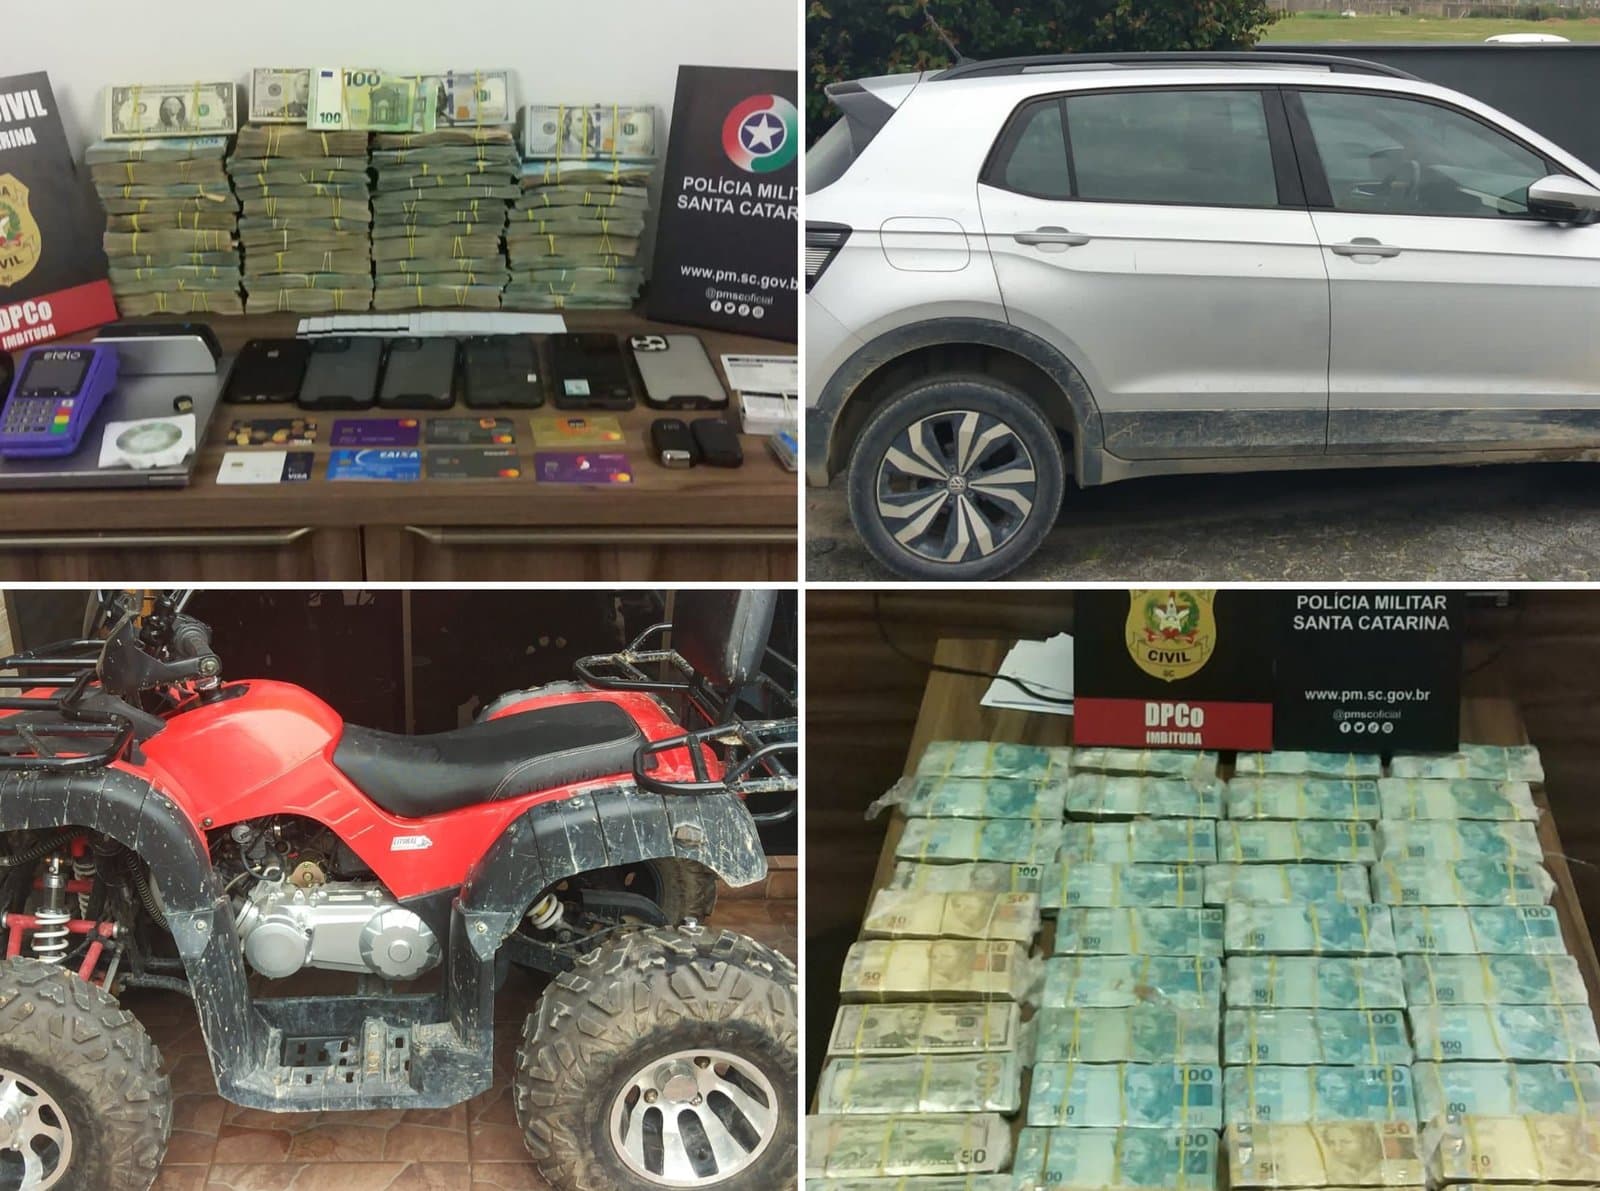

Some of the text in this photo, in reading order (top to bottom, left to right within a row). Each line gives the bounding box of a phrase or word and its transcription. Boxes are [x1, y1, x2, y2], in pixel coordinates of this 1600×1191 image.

[344, 71, 381, 87] 100
[0, 89, 48, 123] IVIL
[320, 112, 341, 123] 100
[682, 176, 752, 197] POLÍCIA
[677, 195, 735, 214] SANTA
[1297, 592, 1448, 610] POLÍCIA MILITAR
[1293, 615, 1450, 630] SANTA CATARINA
[1148, 650, 1191, 663] CIVIL
[1305, 688, 1431, 703] www.pm.sc.gov.br
[1145, 702, 1204, 728] DPCo
[1333, 709, 1401, 721] @pmscoficial
[1522, 908, 1551, 918] 100
[864, 971, 881, 981] 50
[960, 1149, 986, 1164] 50
